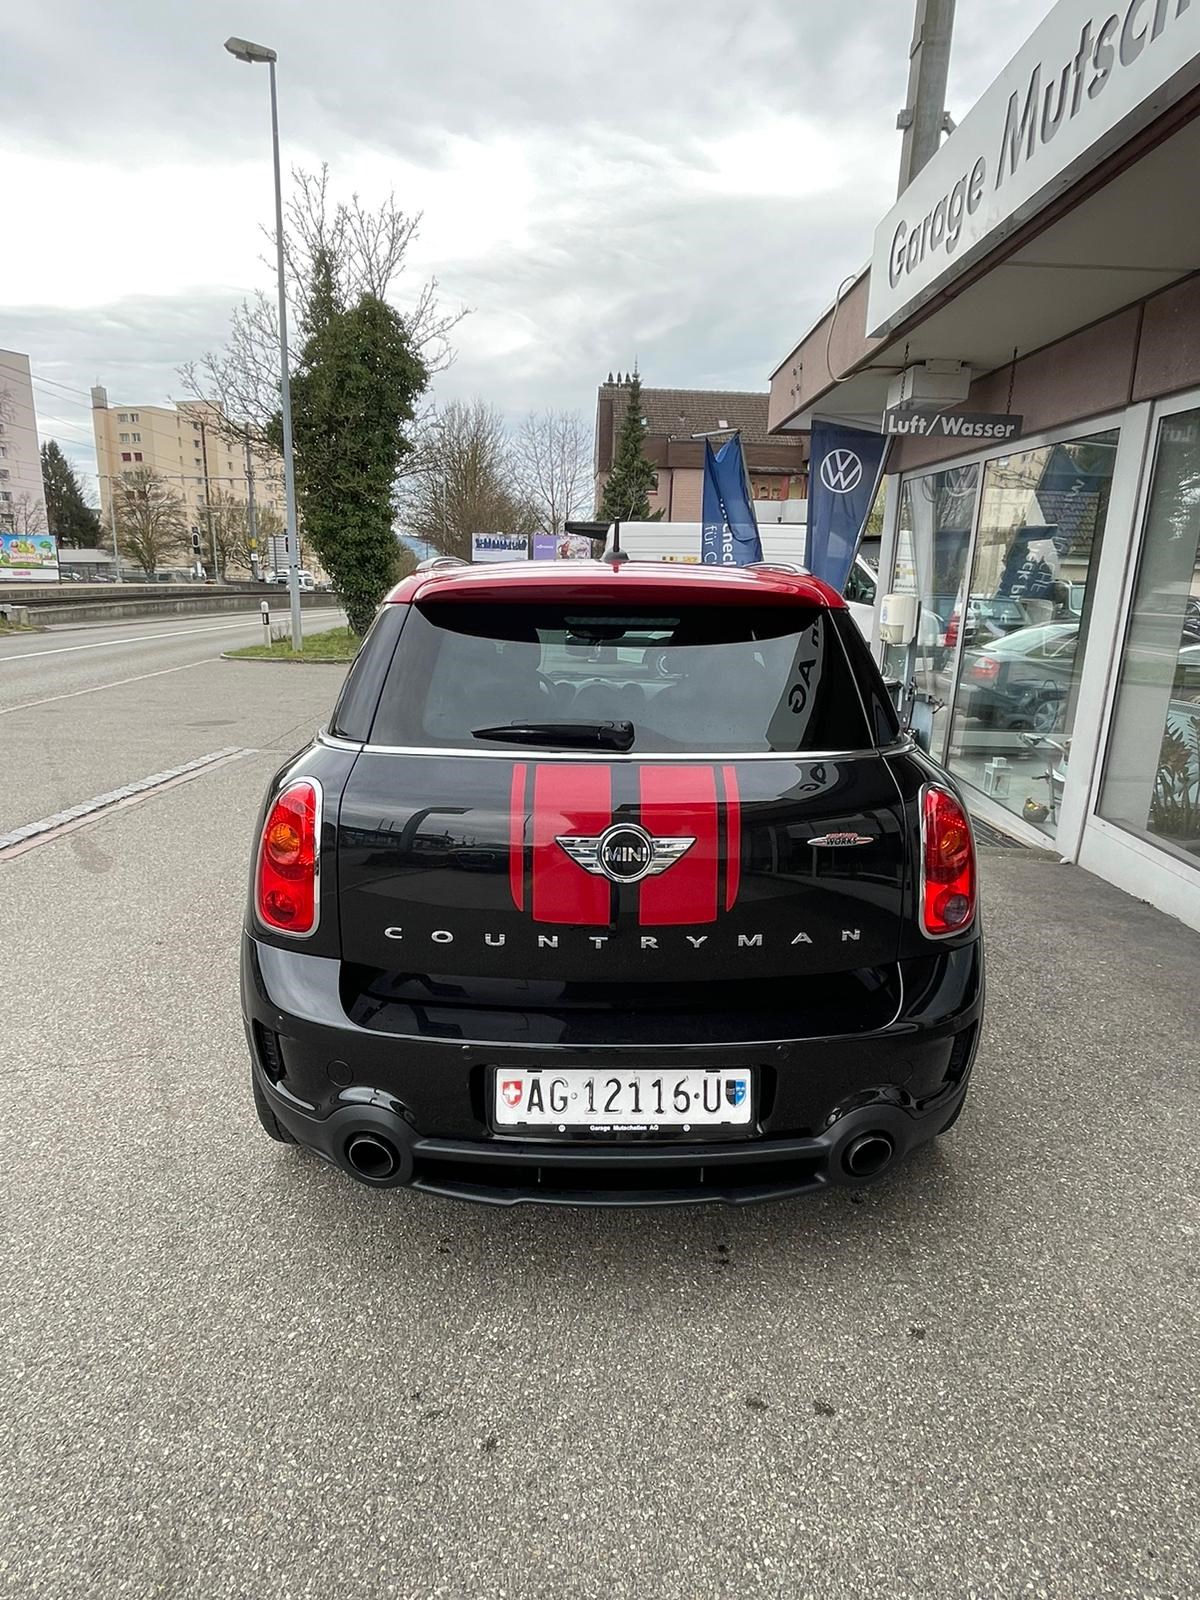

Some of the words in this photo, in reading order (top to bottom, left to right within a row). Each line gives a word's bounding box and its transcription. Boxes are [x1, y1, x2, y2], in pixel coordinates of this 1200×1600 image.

[889, 155, 986, 289] Garage
[888, 415, 1015, 438] Luft/Wasser
[704, 525, 717, 546] für
[704, 552, 717, 565] C
[826, 838, 858, 846] WORKS
[605, 847, 647, 861] MINI
[384, 926, 861, 949] COUNTRYMAN
[589, 1124, 611, 1132] Garage
